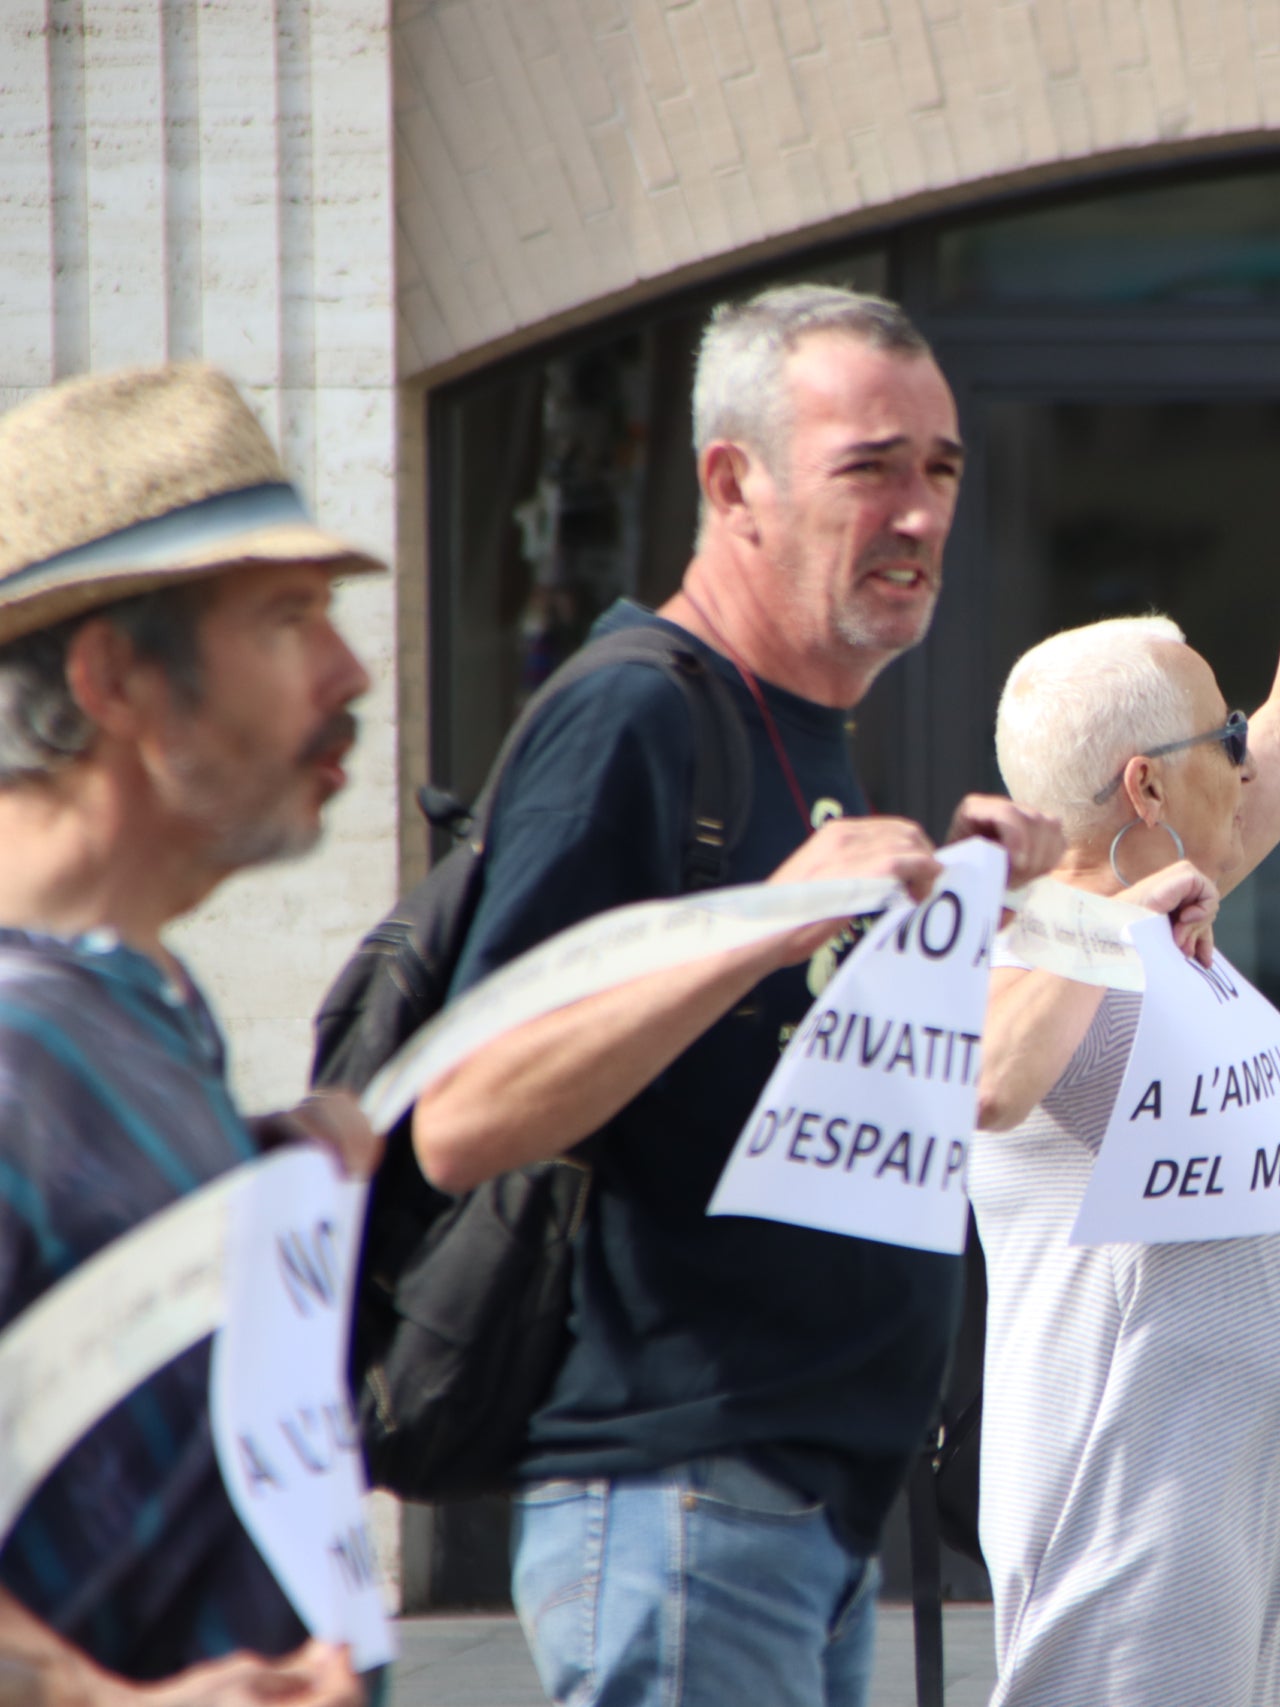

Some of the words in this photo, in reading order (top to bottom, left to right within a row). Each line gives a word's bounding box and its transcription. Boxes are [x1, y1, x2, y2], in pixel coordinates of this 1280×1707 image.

[876, 889, 964, 960] NO
[798, 1009, 982, 1087] PRIVATIT
[1129, 1080, 1162, 1122] A
[746, 1107, 937, 1187] D'ESPAI
[940, 1138, 970, 1196] P
[1142, 1155, 1225, 1199] DEL
